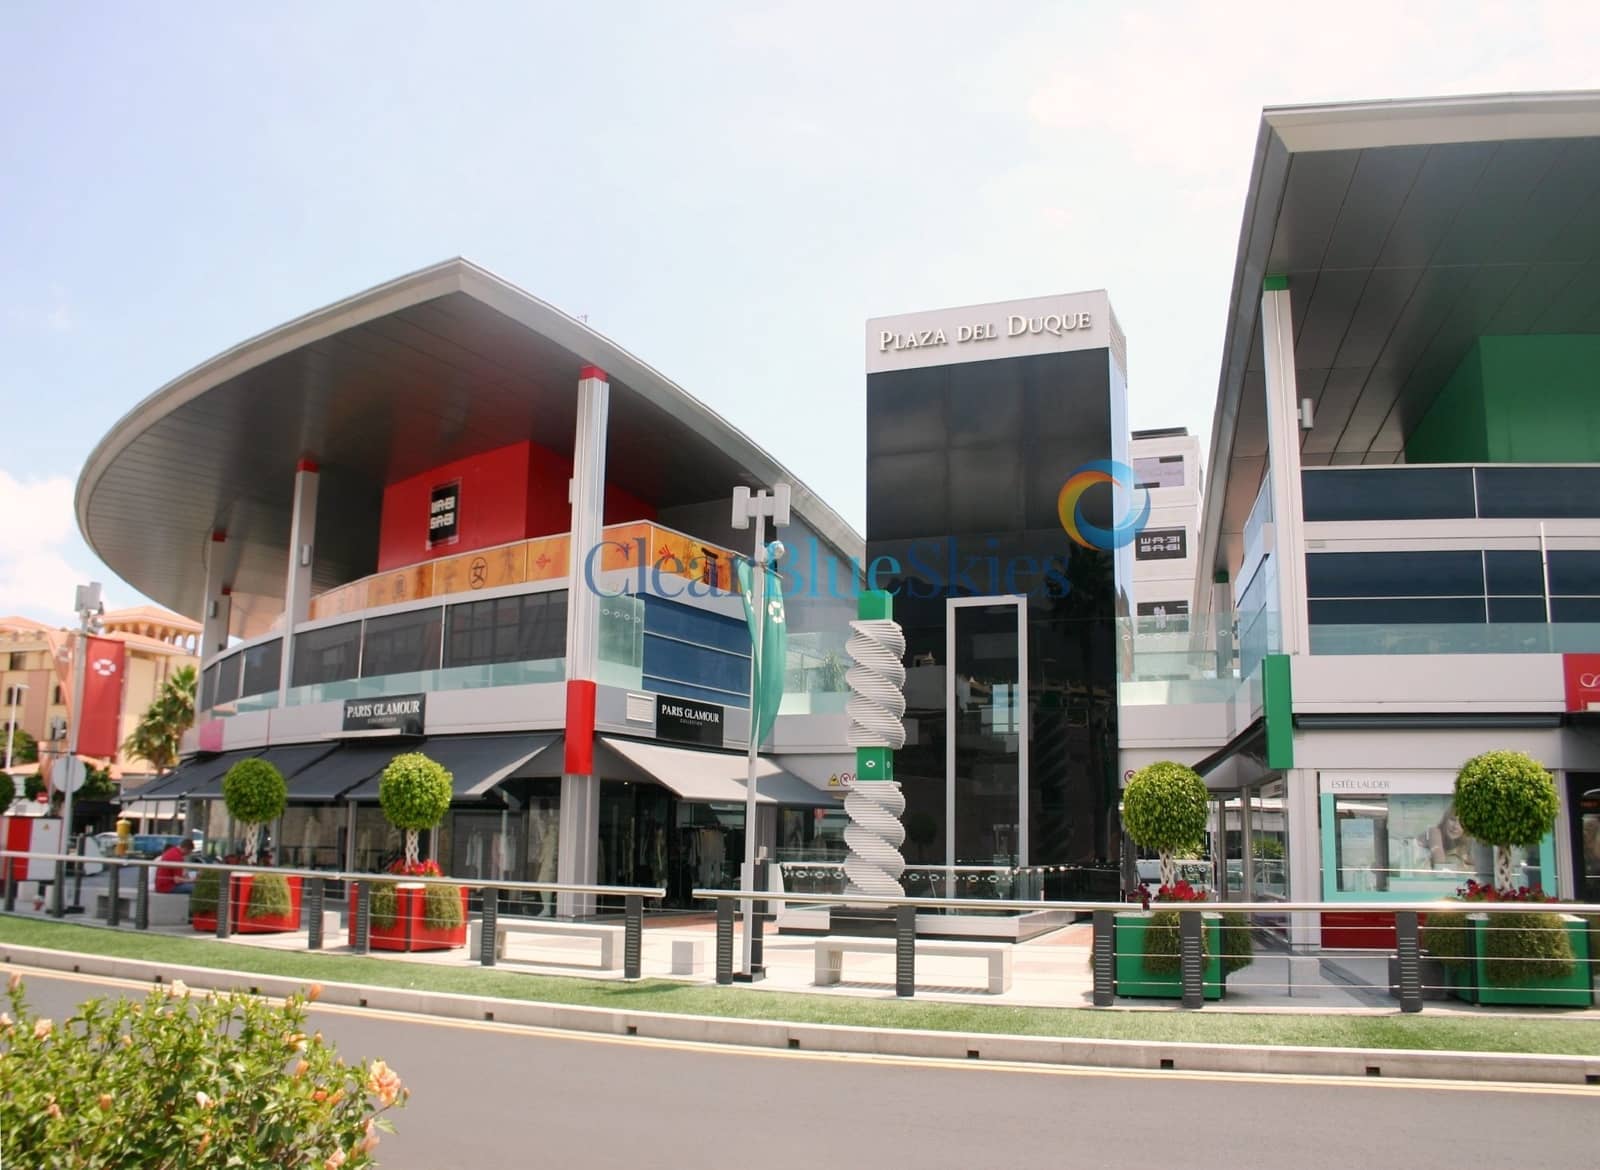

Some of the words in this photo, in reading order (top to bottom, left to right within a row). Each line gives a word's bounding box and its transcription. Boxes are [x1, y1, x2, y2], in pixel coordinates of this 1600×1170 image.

[879, 328, 948, 352] PLAZA
[957, 323, 997, 343] DEL
[1007, 311, 1091, 337] DUQUE
[347, 704, 372, 718] PARIS
[373, 700, 420, 716] GLAMOUR
[661, 704, 683, 717] PARIS
[684, 708, 720, 723] GLAMOUR
[1357, 780, 1391, 789] LAUDER
